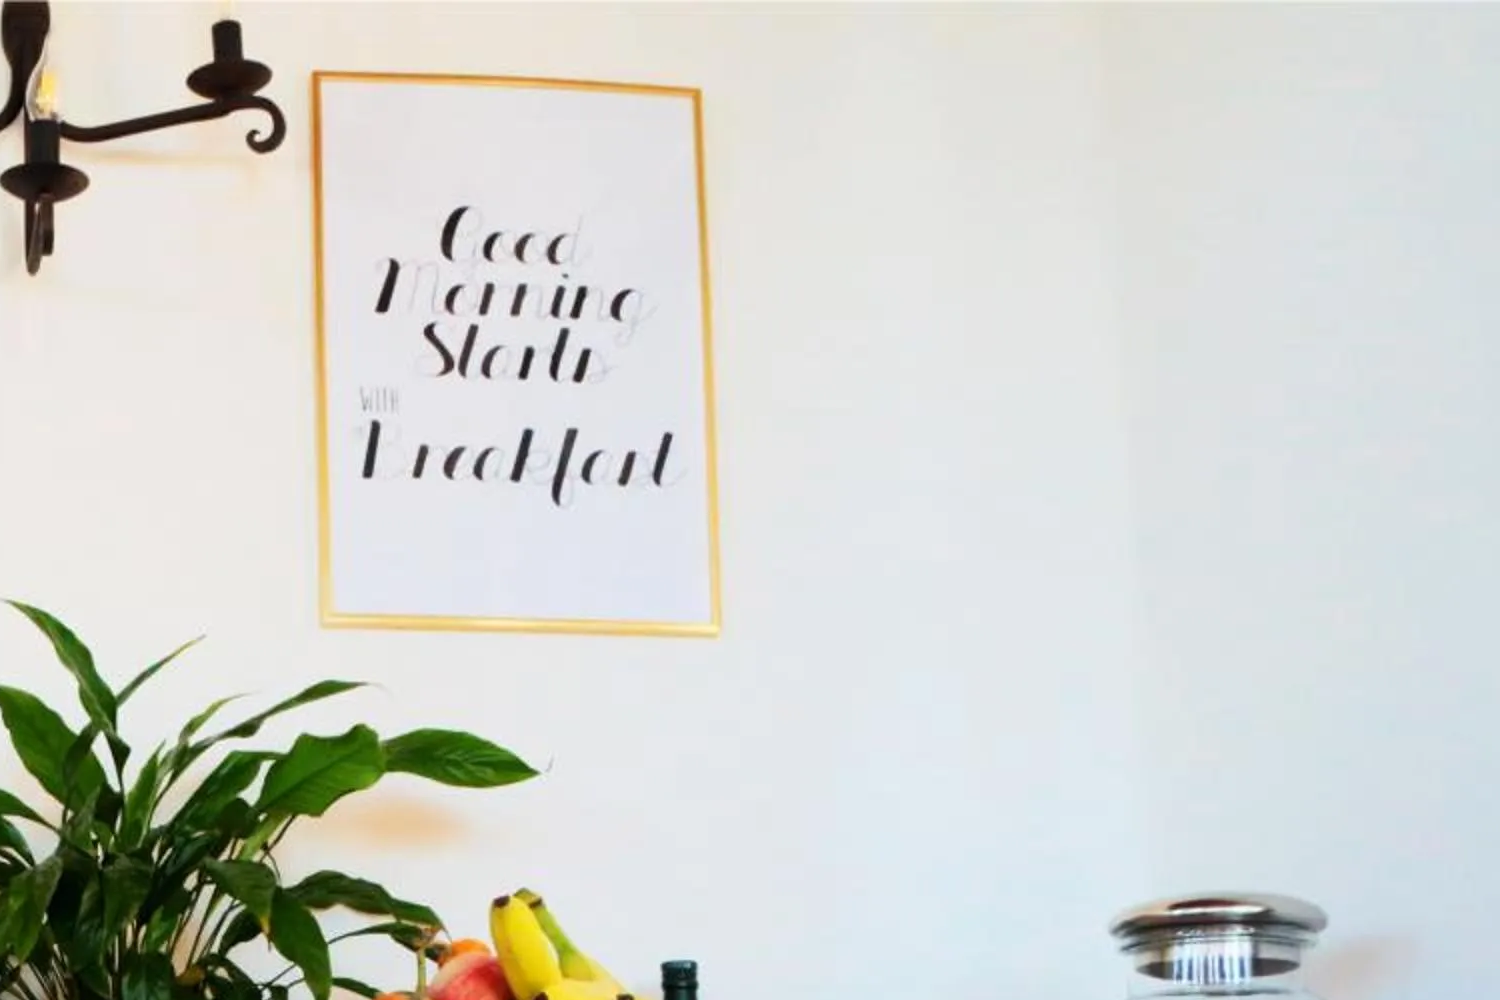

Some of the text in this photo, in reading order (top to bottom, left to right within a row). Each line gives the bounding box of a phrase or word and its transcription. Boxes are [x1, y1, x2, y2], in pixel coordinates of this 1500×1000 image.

[440, 205, 586, 270] Good
[375, 256, 657, 343] Morning
[416, 320, 613, 384] Starts
[359, 385, 399, 414] WITH
[353, 419, 689, 507] Breakfast
